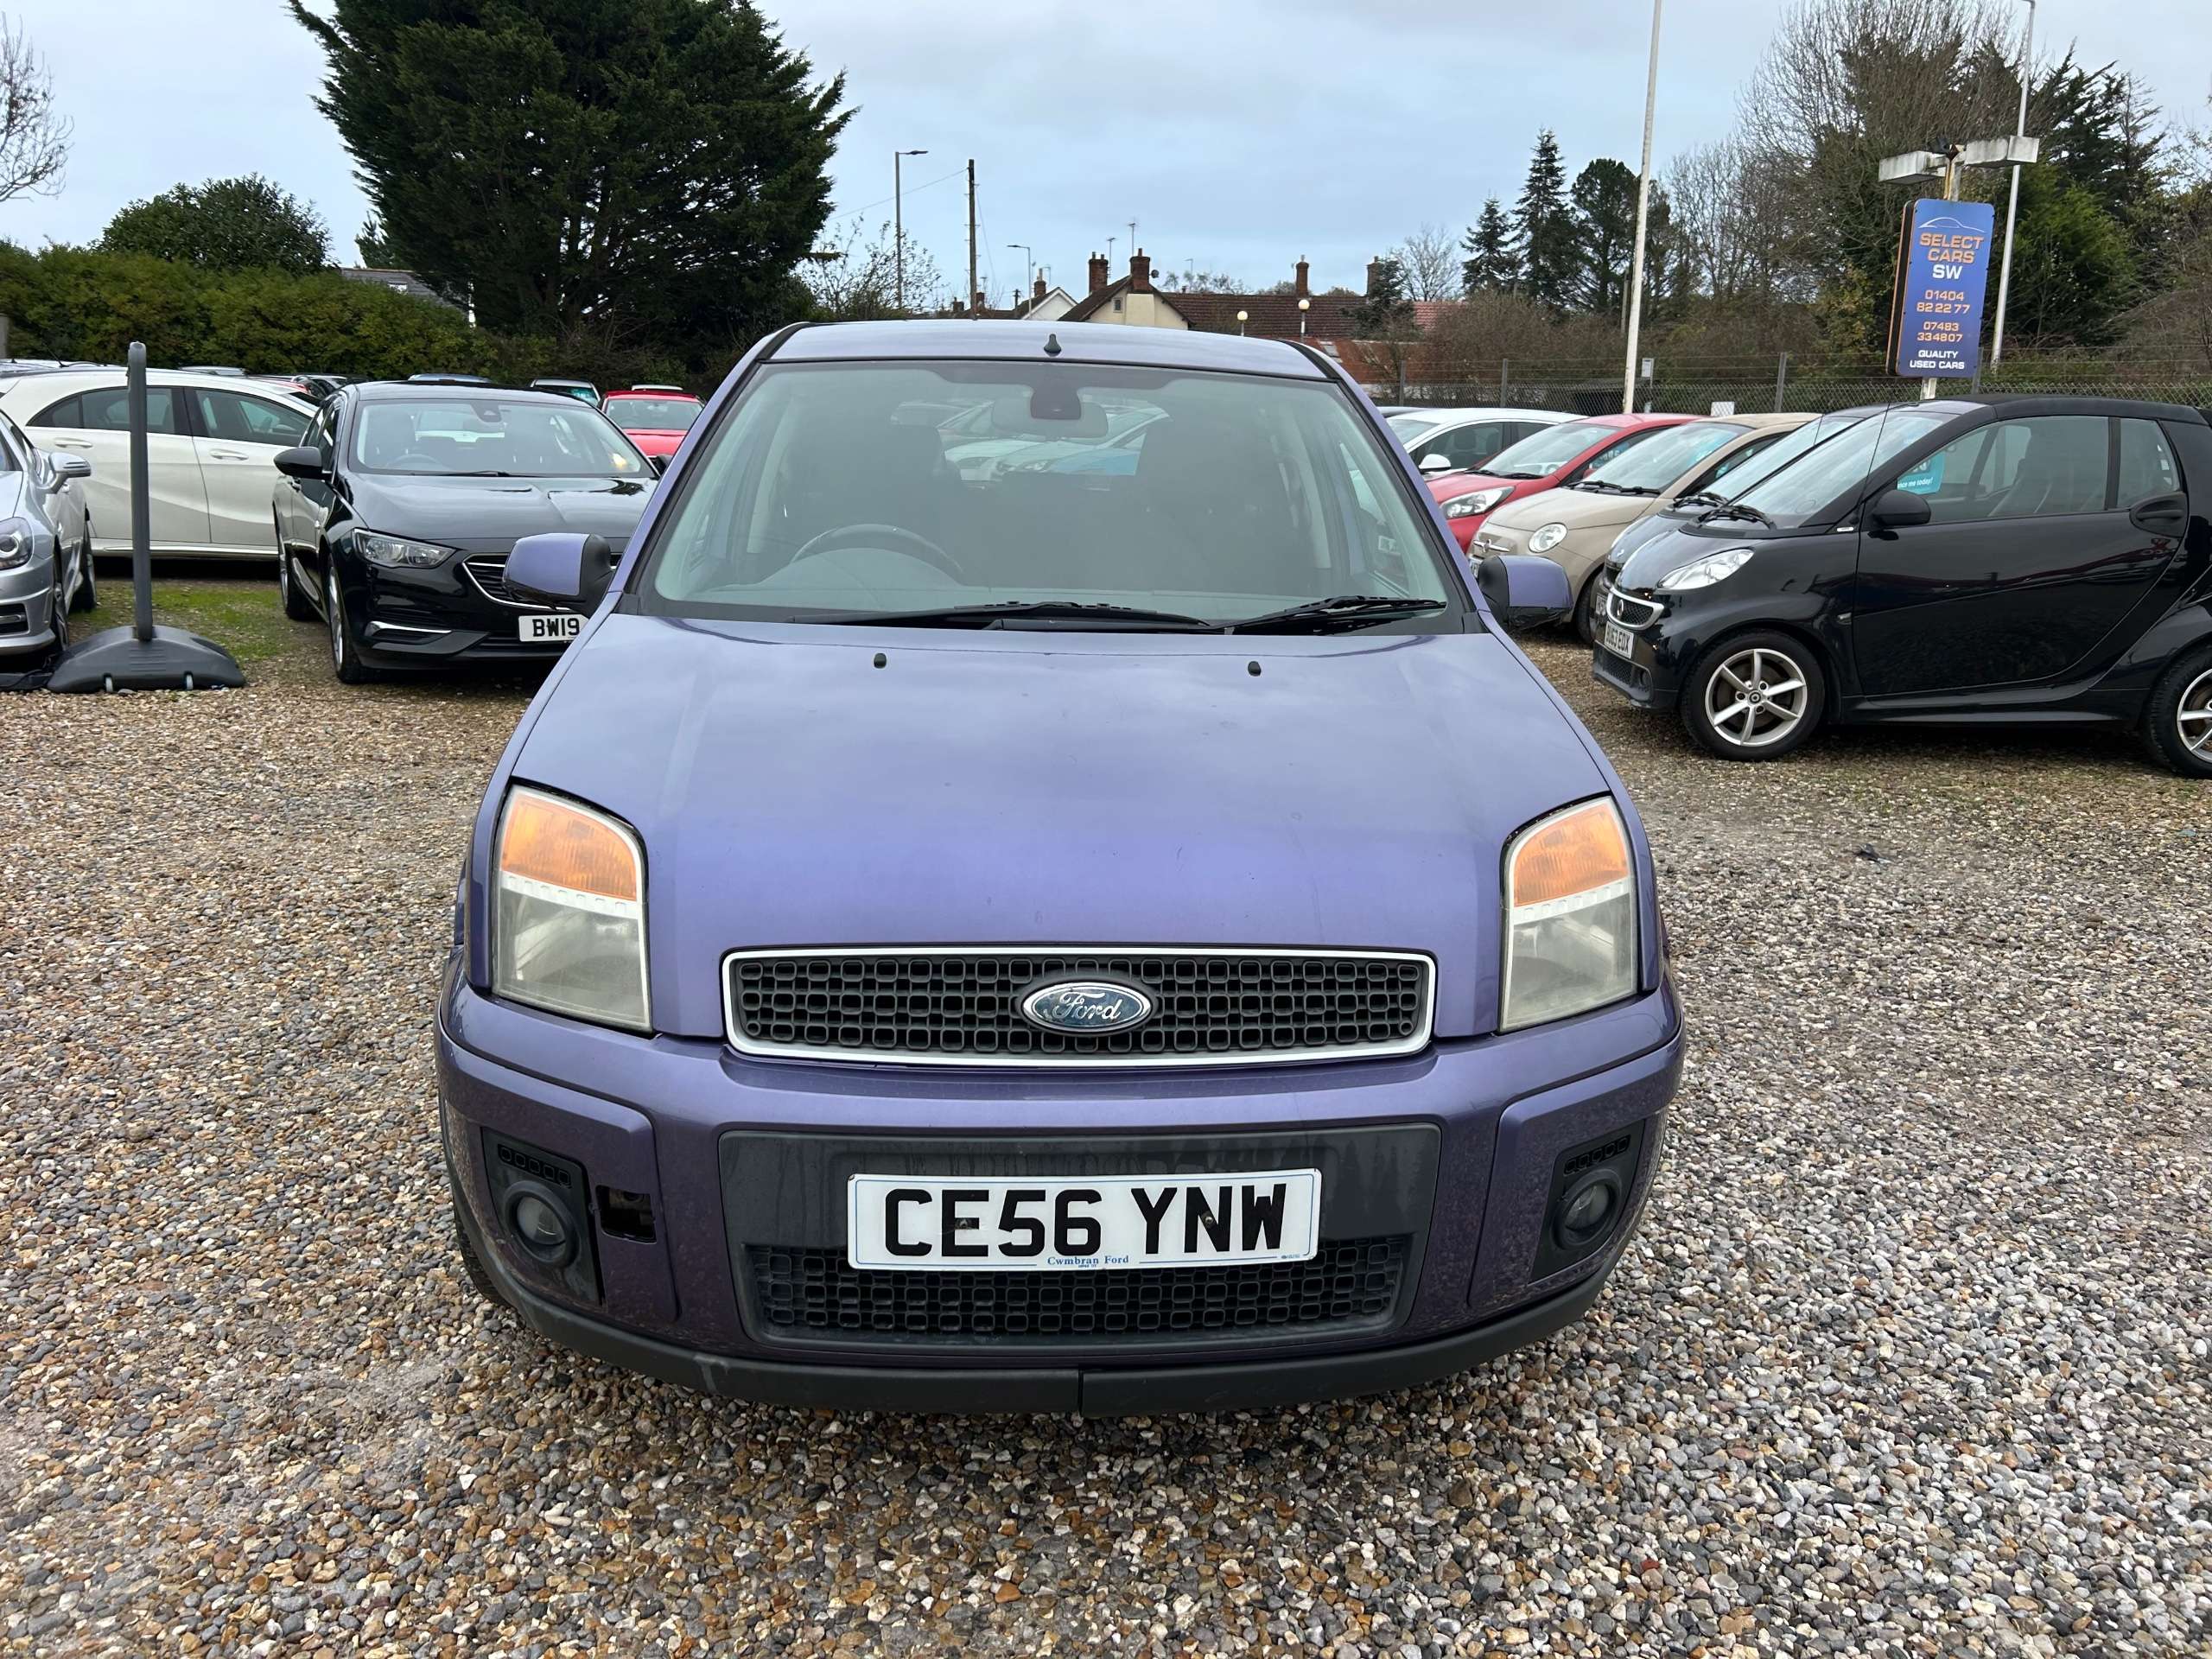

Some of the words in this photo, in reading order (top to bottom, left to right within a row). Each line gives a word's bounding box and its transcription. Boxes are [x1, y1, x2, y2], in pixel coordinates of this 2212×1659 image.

[1919, 232, 1985, 250] SELECT
[1928, 248, 1975, 264] CARS
[1932, 264, 1963, 279] SW
[1924, 289, 1964, 302] 01404
[1917, 332, 1963, 342] 334807
[1918, 349, 1959, 359] QUALITY
[1910, 359, 1936, 369] USED
[1938, 360, 1965, 370] CARS
[531, 618, 581, 637] BW19
[1052, 991, 1123, 1020] Ford
[885, 1189, 1102, 1256] CE56
[1130, 1183, 1287, 1255] YNW
[1047, 1256, 1099, 1266] Cwmbran
[1104, 1255, 1129, 1264] Ford
